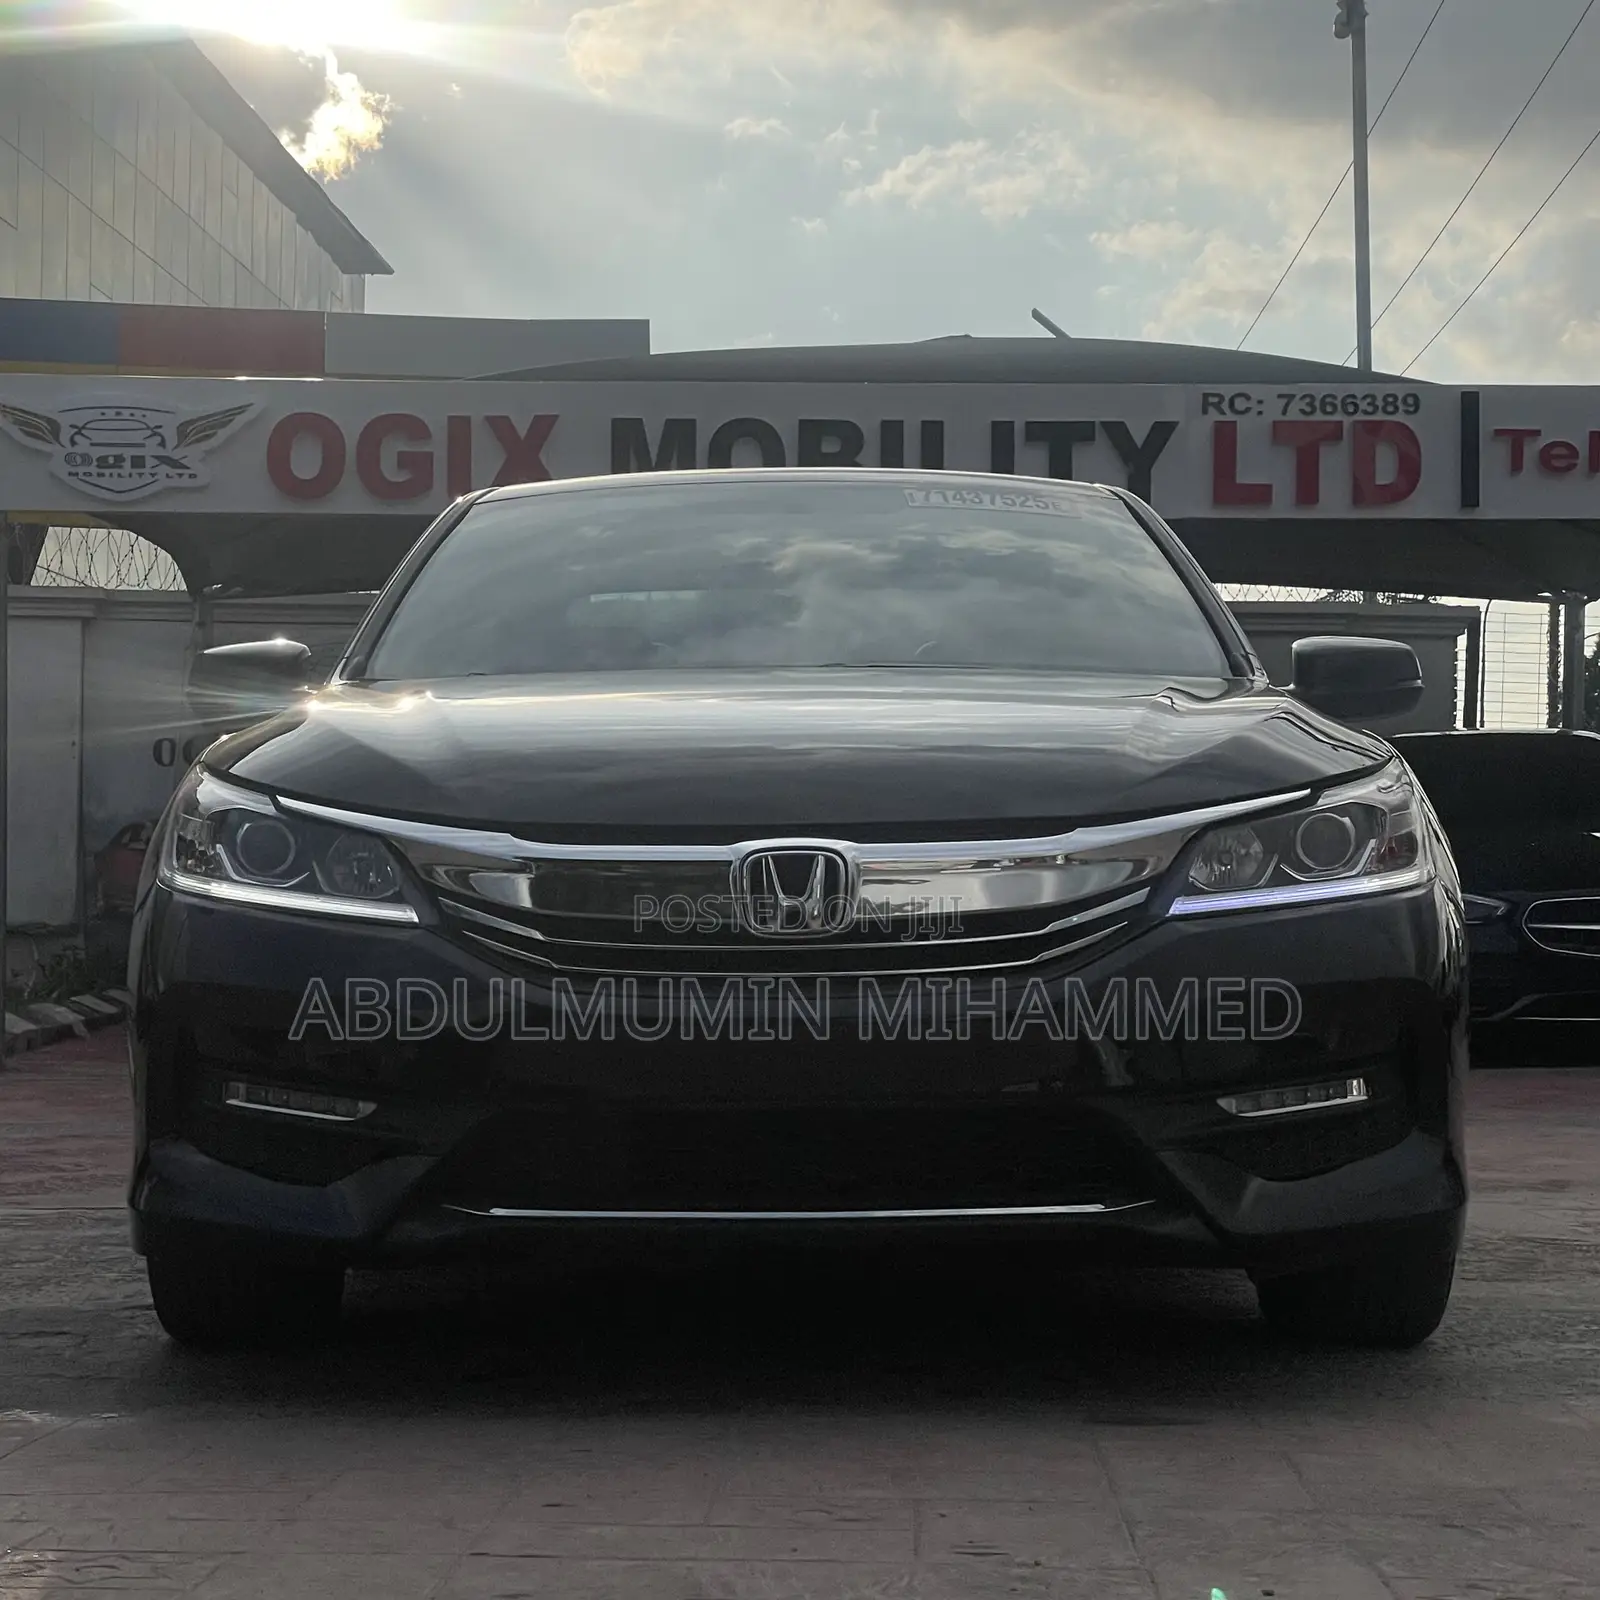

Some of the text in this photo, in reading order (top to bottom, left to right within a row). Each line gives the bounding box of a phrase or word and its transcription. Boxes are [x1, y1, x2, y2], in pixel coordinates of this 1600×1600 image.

[1201, 392, 1421, 416] RC: 7366389
[266, 412, 560, 501] OGIX
[1212, 420, 1422, 506] LTD
